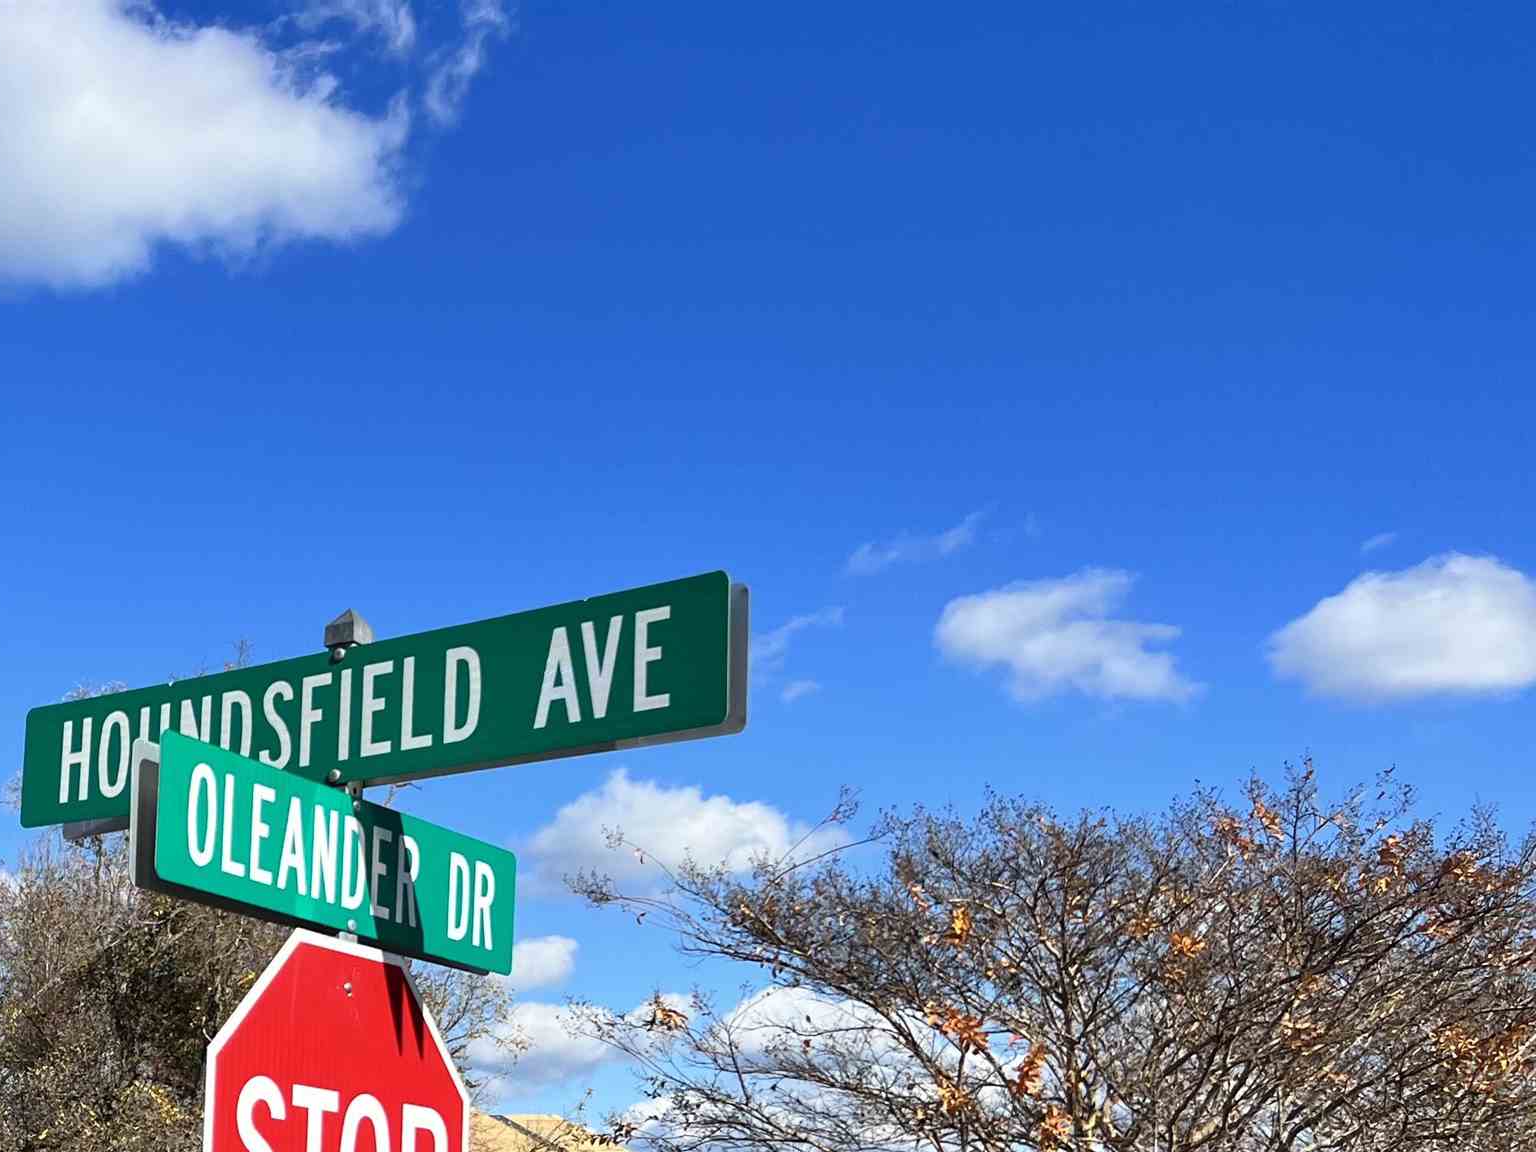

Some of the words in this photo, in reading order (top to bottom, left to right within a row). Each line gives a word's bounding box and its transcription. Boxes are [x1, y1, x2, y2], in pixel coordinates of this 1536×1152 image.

[534, 606, 671, 729] AVE
[187, 763, 421, 928] OLEANDER
[447, 851, 496, 951] DR
